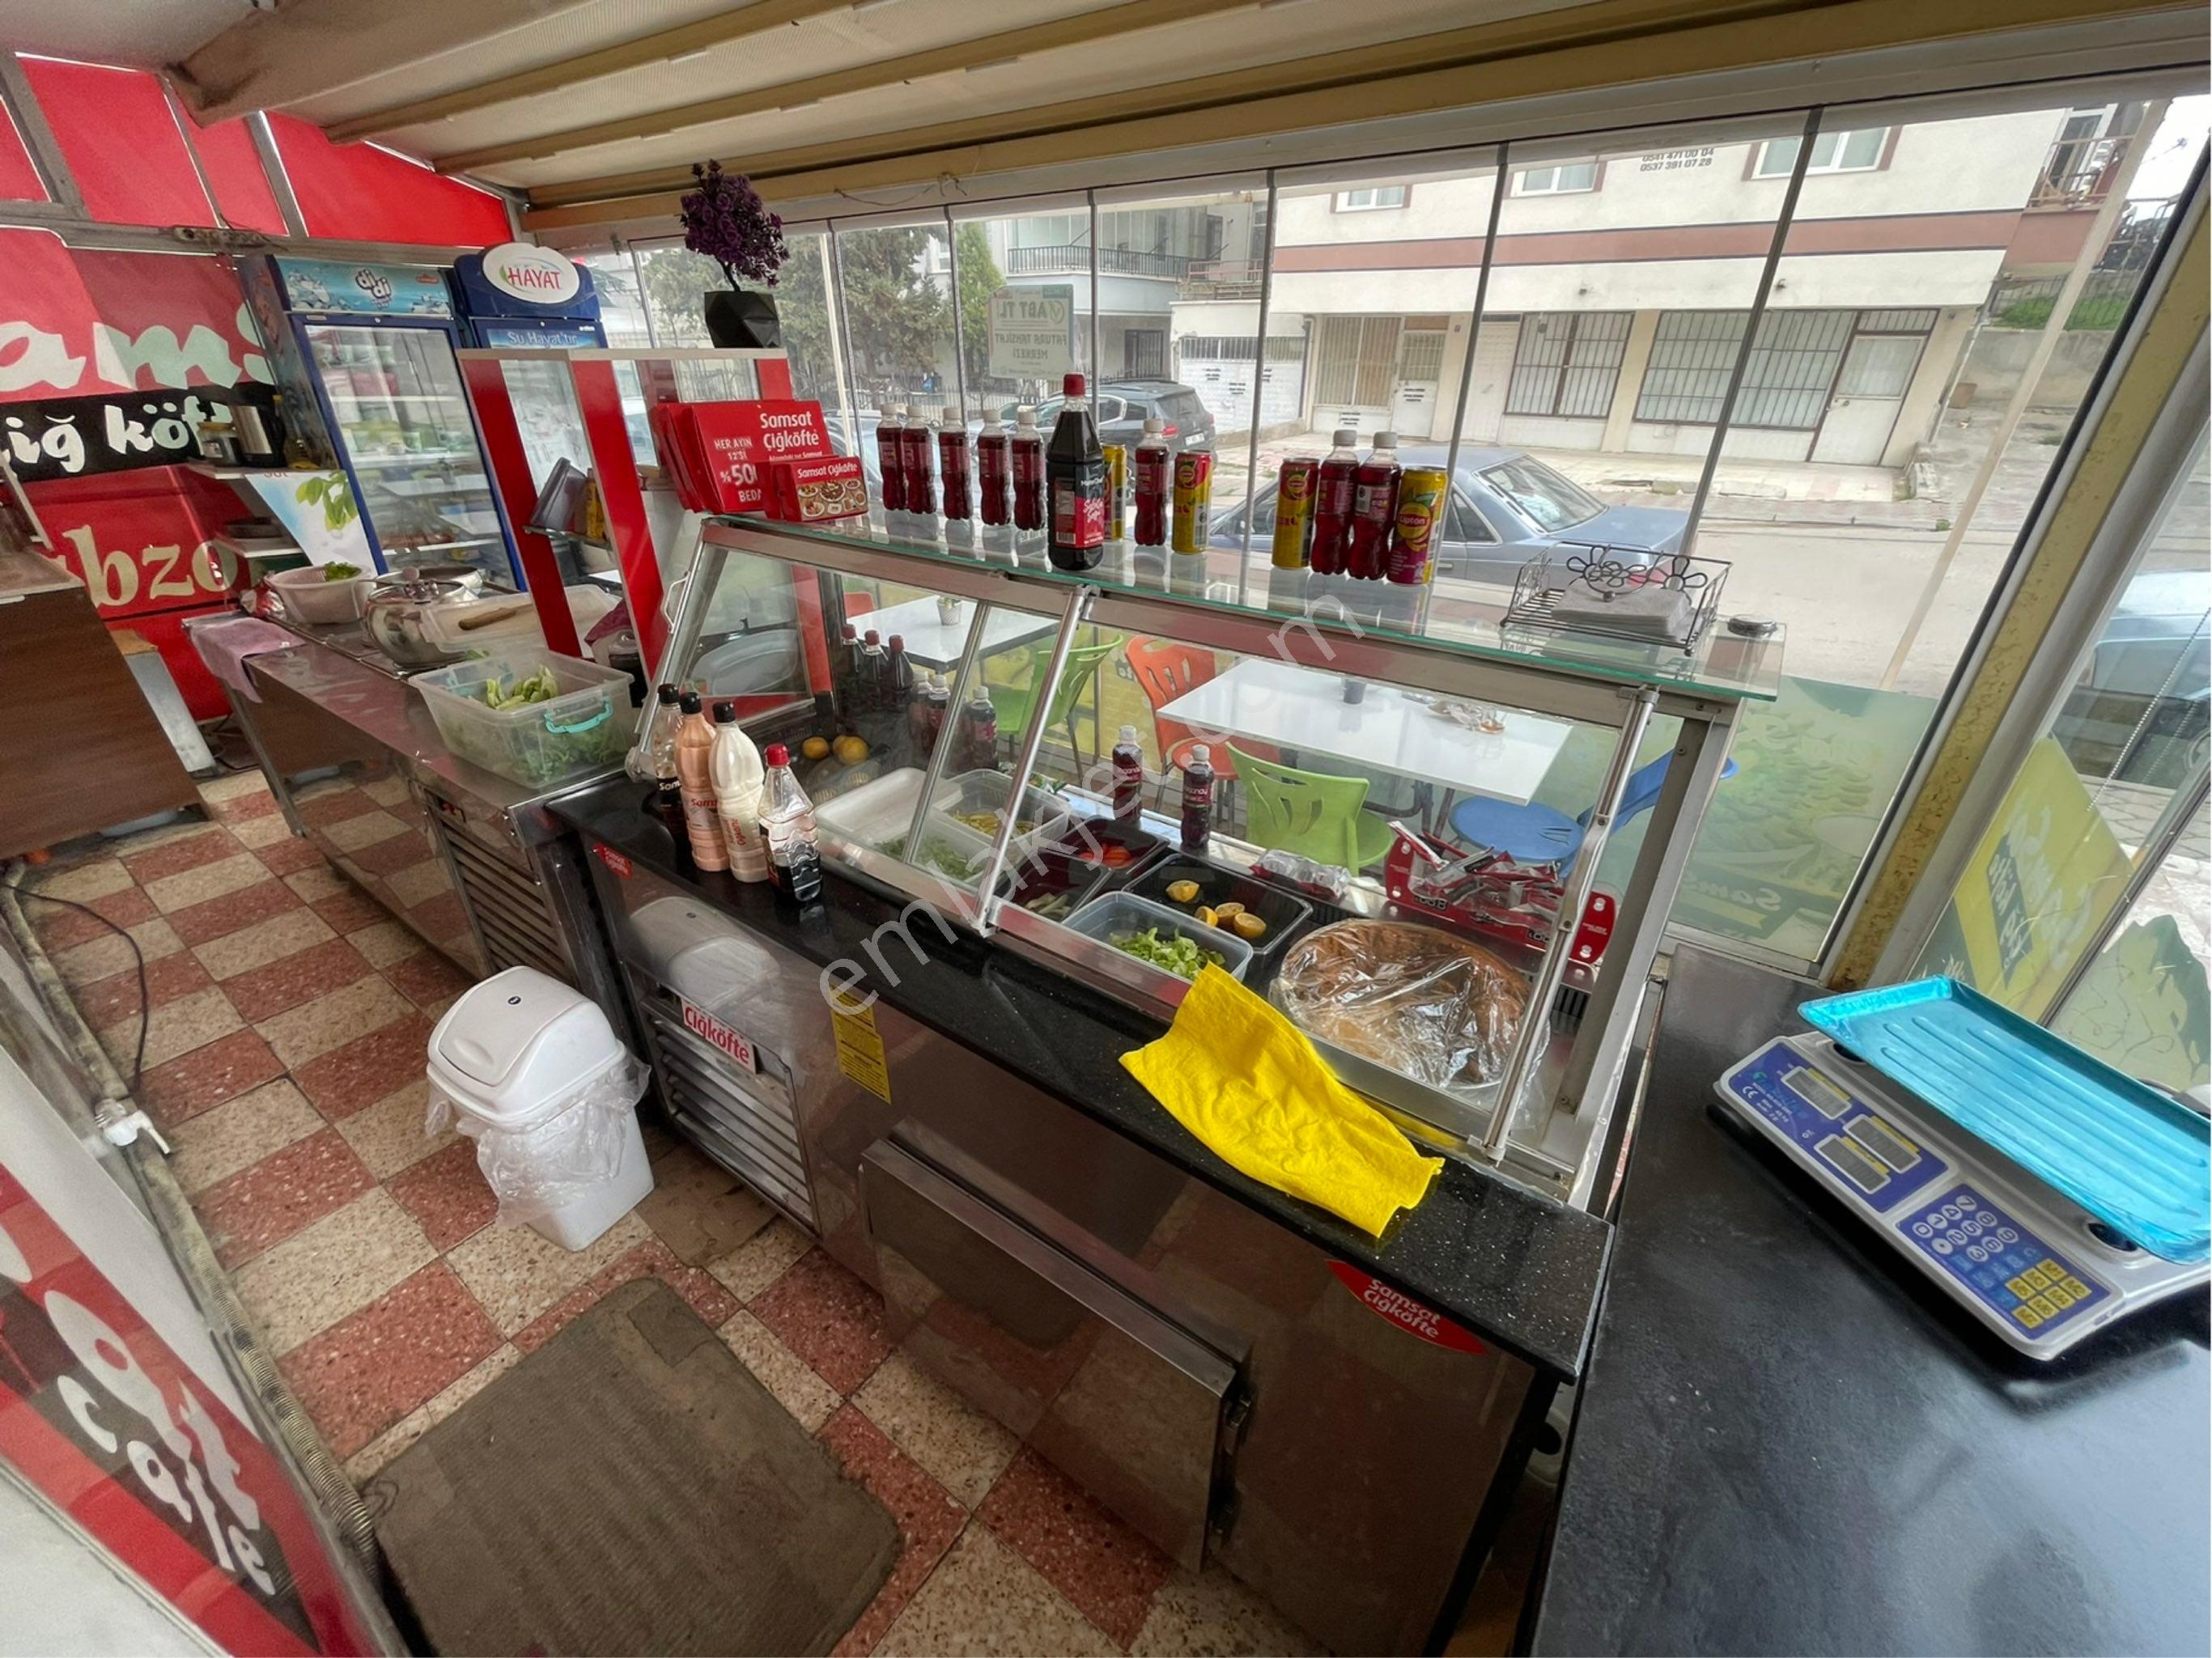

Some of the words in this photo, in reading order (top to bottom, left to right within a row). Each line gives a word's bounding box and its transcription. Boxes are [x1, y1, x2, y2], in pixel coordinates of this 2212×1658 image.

[1640, 163, 1663, 172] 0537
[1683, 159, 1698, 168] 07
[507, 266, 562, 290] HAYAT
[759, 410, 813, 429] Samsat
[0, 413, 85, 474] iğ
[104, 396, 233, 456] köf
[714, 438, 730, 450] HER
[732, 436, 753, 448] AYIN
[762, 428, 820, 452] Çiğköfte
[797, 465, 827, 478] Samsat
[1399, 515, 1426, 526] Lipton
[1369, 1278, 1441, 1325] Samsat
